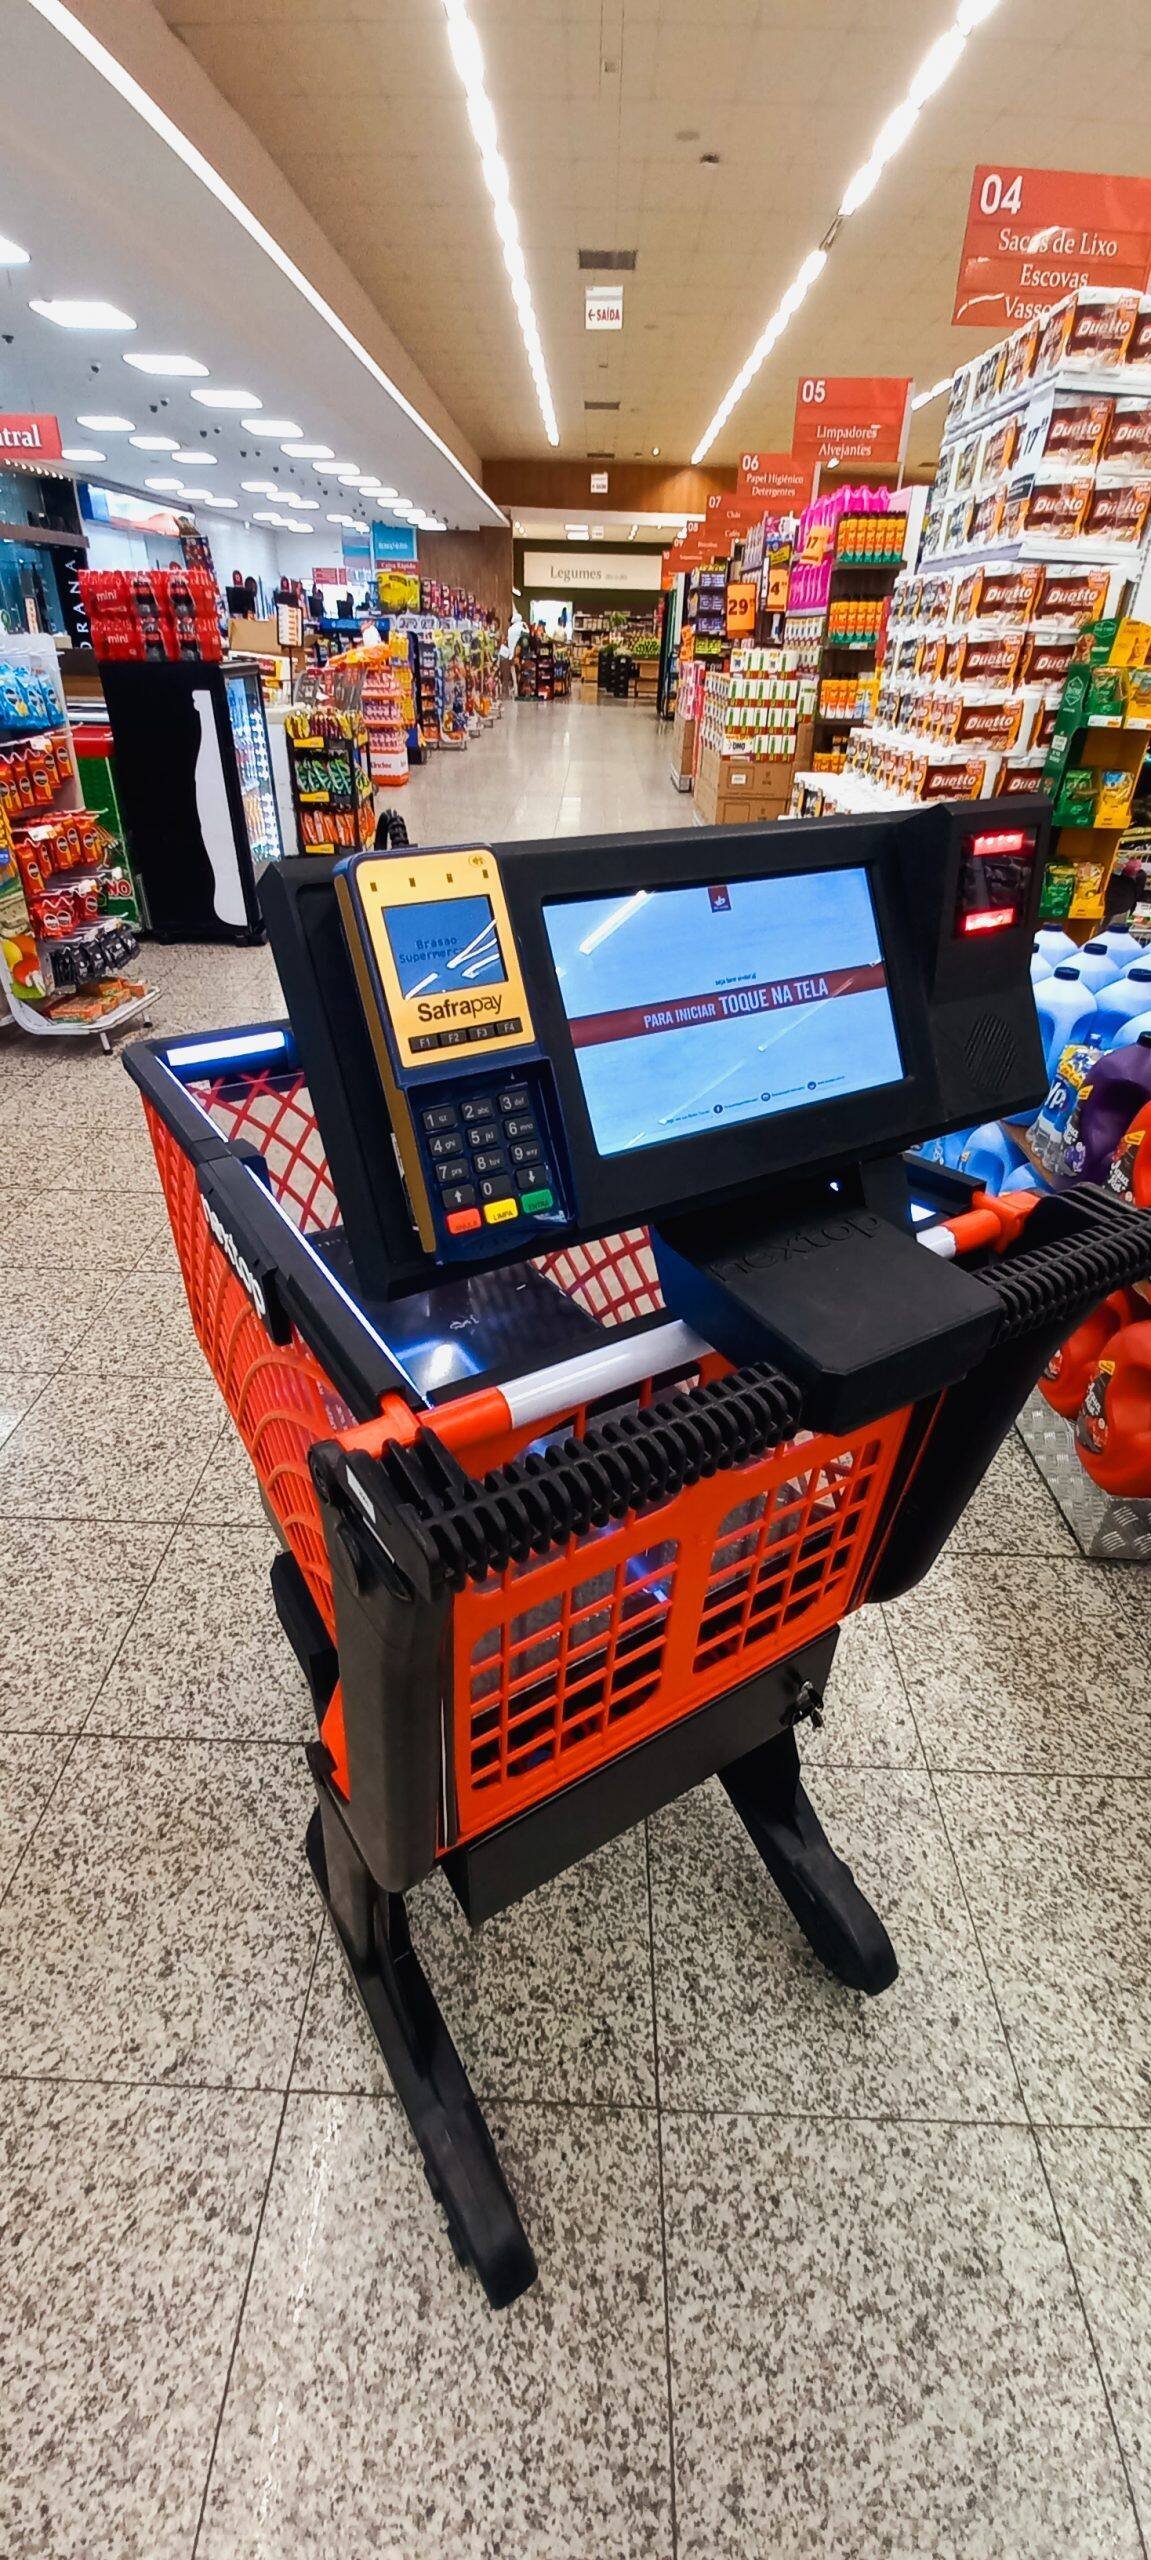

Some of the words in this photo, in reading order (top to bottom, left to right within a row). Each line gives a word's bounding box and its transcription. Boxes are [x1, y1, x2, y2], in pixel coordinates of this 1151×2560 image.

[979, 173, 1023, 215] 04
[998, 228, 1048, 253] Sacs
[1053, 230, 1076, 254] de
[1080, 232, 1118, 256] Lixo
[1020, 263, 1089, 288] Escovas
[597, 307, 620, 321] SAÍDA
[1004, 296, 1052, 319] Vasso
[802, 380, 826, 403] 05
[816, 425, 879, 441] Limpadores
[818, 443, 872, 460] Alvejantes
[742, 454, 759, 471] 06
[746, 473, 767, 485] Papel
[752, 486, 796, 498] Detergentes
[708, 496, 722, 508] 07
[688, 523, 699, 532] 08
[550, 565, 602, 582] Legumes
[96, 590, 118, 602] mini
[728, 599, 748, 616] 29
[107, 634, 129, 645] mini
[399, 947, 464, 964] Supermerc
[417, 994, 502, 1022] Safrapay
[643, 1011, 673, 1029] PARA
[674, 1003, 716, 1023] INICIAR
[718, 989, 770, 1015] TOQUE
[771, 986, 794, 1006] NA
[794, 977, 829, 1000] TELA
[420, 1038, 431, 1048] F1
[448, 1032, 459, 1043] F2
[476, 1027, 488, 1038] F3
[504, 1022, 515, 1032] F4
[502, 1097, 512, 1110] 3
[464, 1105, 474, 1119] 2
[427, 1114, 435, 1127] 1
[508, 1122, 518, 1135] 6
[471, 1130, 480, 1144] 5
[433, 1139, 443, 1152] 4
[514, 1147, 523, 1160] 9
[477, 1157, 486, 1170] 8
[438, 1166, 447, 1179] 7
[483, 1182, 492, 1196] 0
